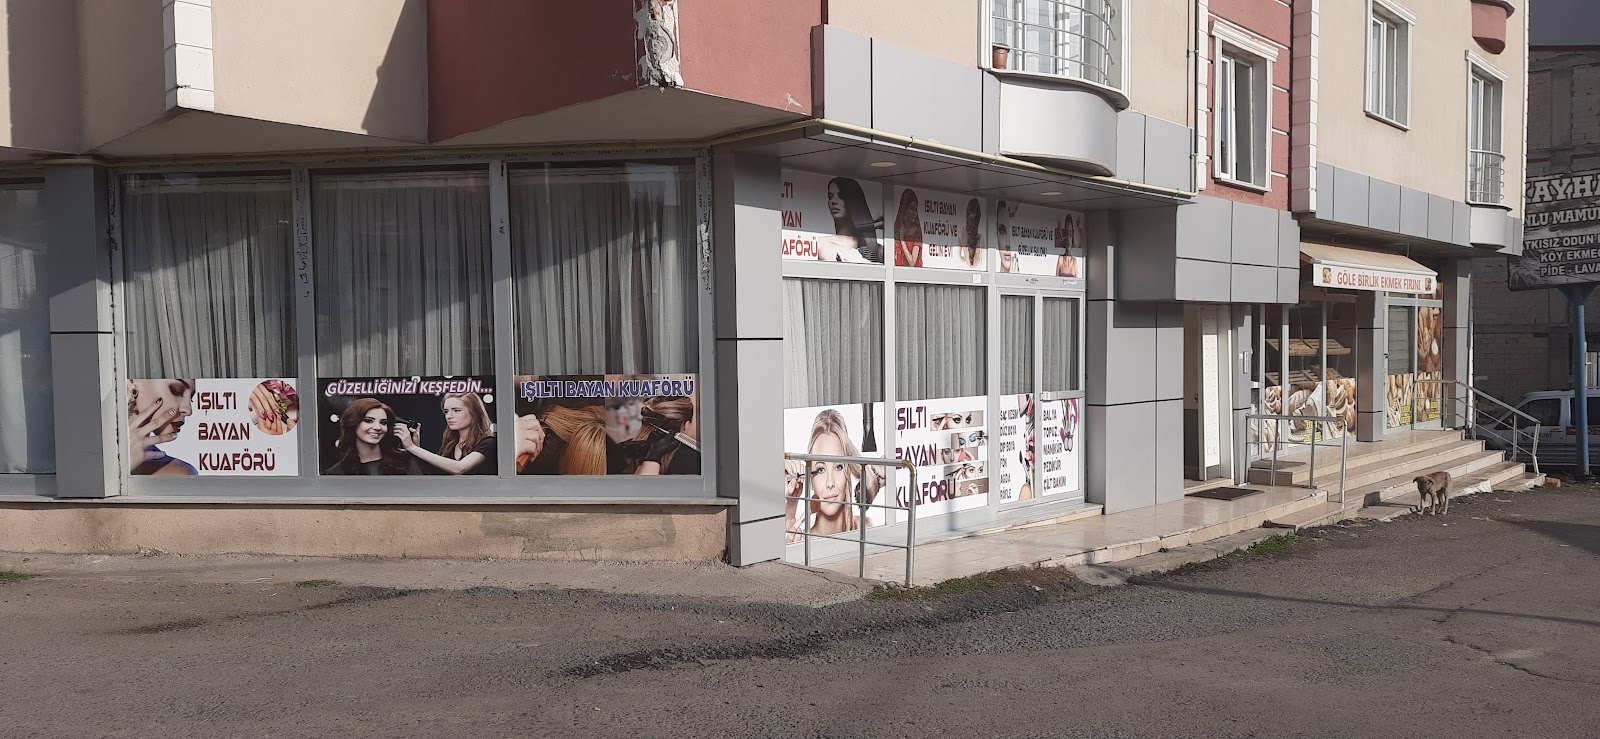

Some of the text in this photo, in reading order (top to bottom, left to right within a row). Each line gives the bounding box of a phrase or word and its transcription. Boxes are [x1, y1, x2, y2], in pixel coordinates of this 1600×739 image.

[781, 182, 794, 198] TI
[940, 201, 957, 216] BAYAN
[1525, 204, 1600, 228] NLU MAMÜ
[950, 224, 958, 238] VE
[1522, 235, 1594, 250] TKISIZ ODUN
[1540, 252, 1564, 263] KÖY
[1540, 264, 1566, 276] PİDE
[1337, 270, 1421, 290] GÖLE BİRLİK EKMEK FIRINI
[326, 378, 494, 396] GÜZELLİĞİNİZİ KEŞFEDİN...
[520, 376, 695, 402] IŞILTI BAYAN KUAFÖRÜ
[197, 392, 237, 416] IŞILTI
[198, 422, 250, 440] BAYAN
[200, 448, 275, 471] KUAFÖRÜ
